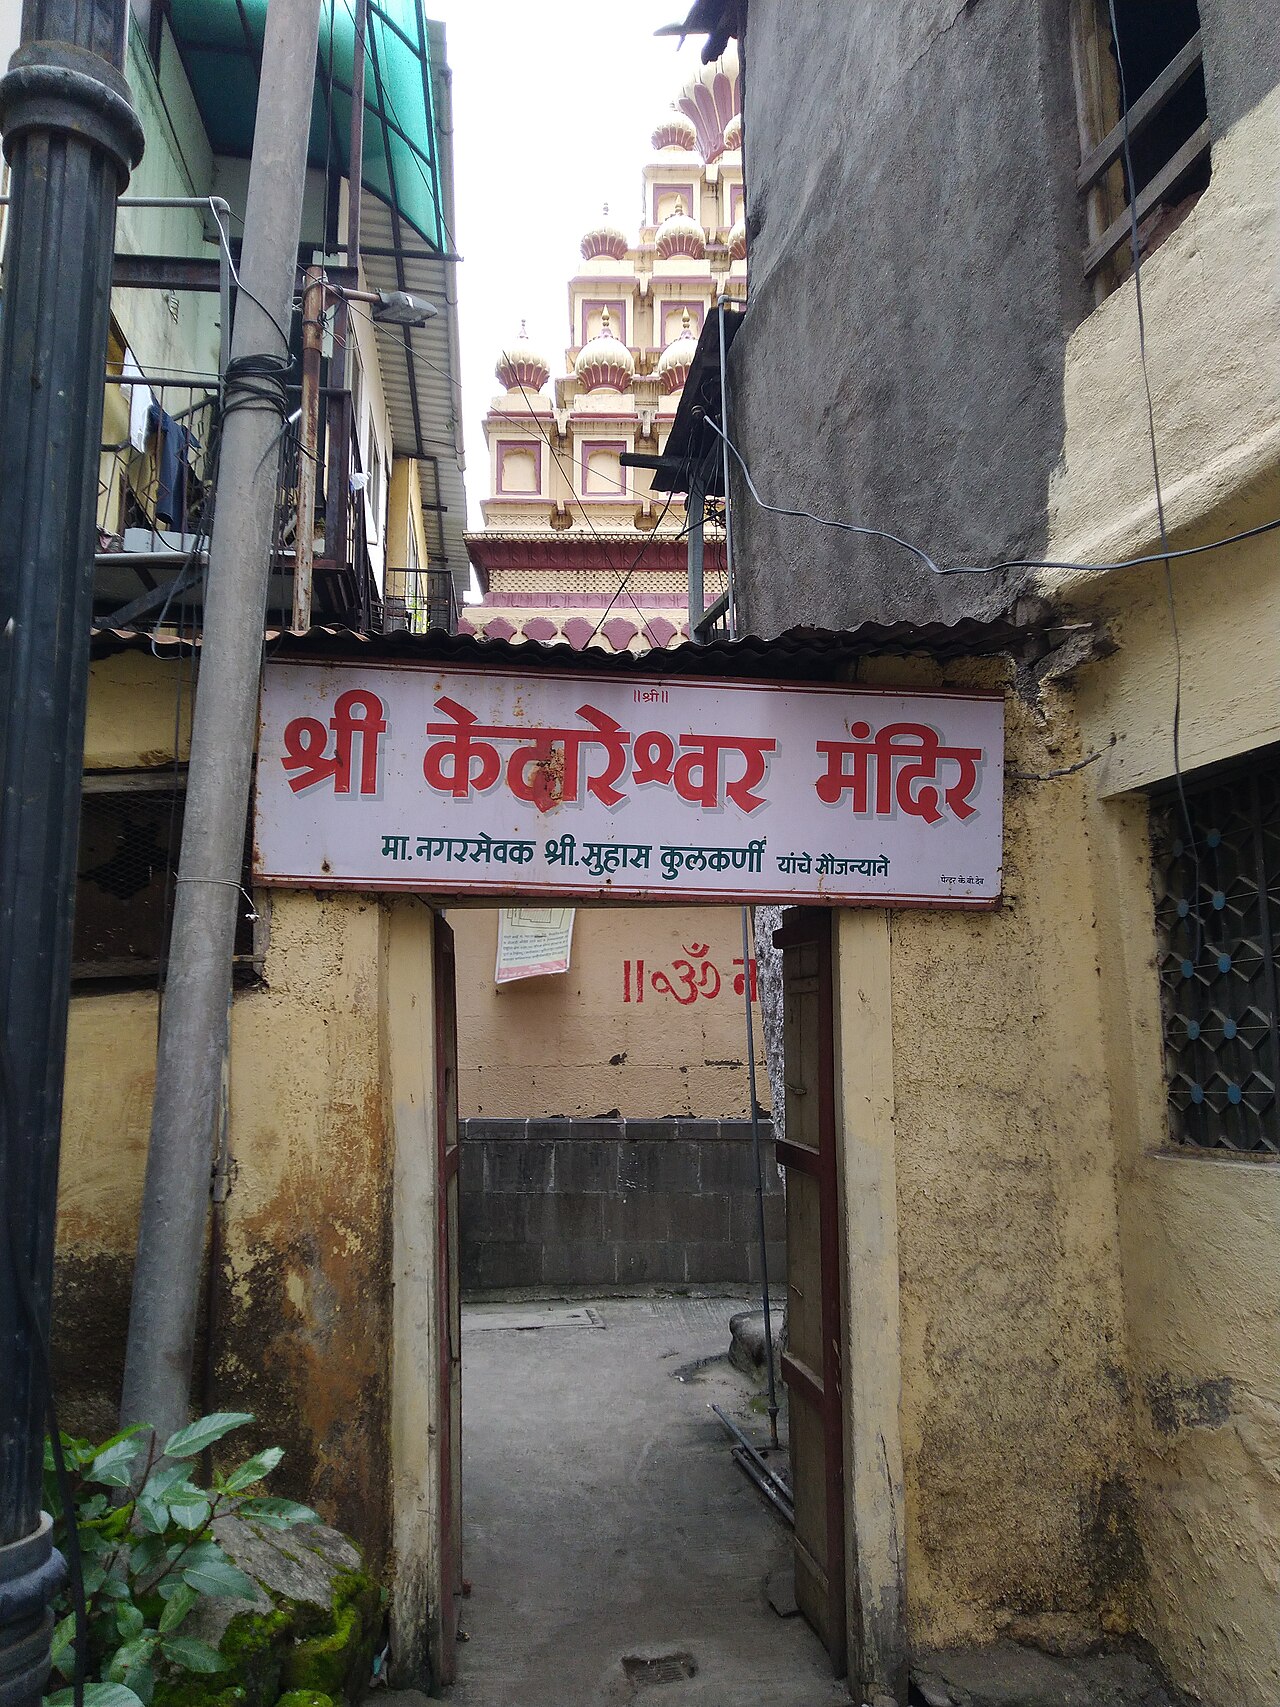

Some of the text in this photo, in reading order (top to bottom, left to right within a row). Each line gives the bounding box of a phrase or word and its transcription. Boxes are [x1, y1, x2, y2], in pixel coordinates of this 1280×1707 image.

[280, 689, 982, 824] श्री केदारेश्वर मंदिर
[660, 840, 767, 880] कुलकर्णी
[776, 851, 813, 874] यांचे
[814, 853, 890, 877] सौजन्याने
